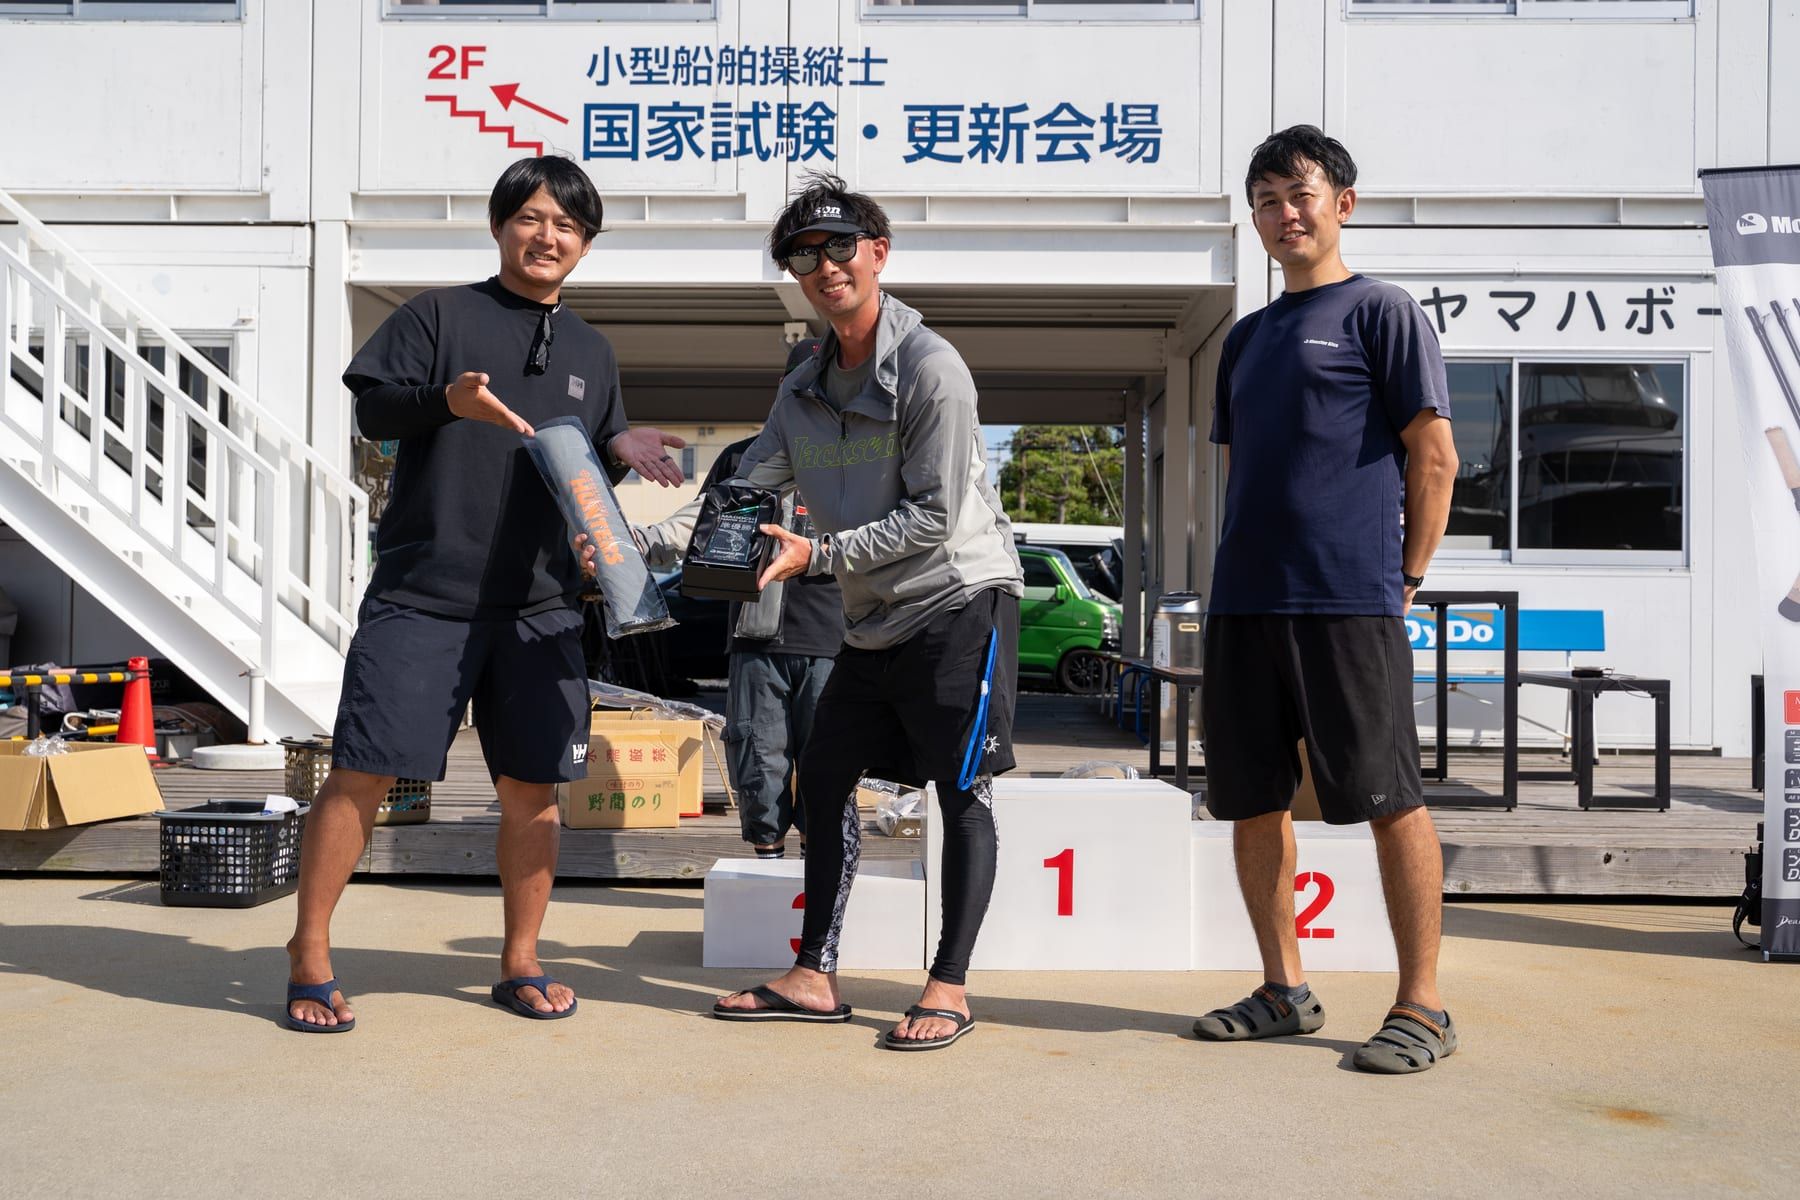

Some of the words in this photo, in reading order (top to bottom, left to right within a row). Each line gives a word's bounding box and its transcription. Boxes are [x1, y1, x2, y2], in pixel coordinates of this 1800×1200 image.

[428, 45, 485, 79] 2F
[586, 45, 888, 87] 小型船舶操縦士
[581, 101, 1163, 164] 国家試験・更新会場
[1043, 849, 1074, 916] 1
[1294, 872, 1335, 939] 2
